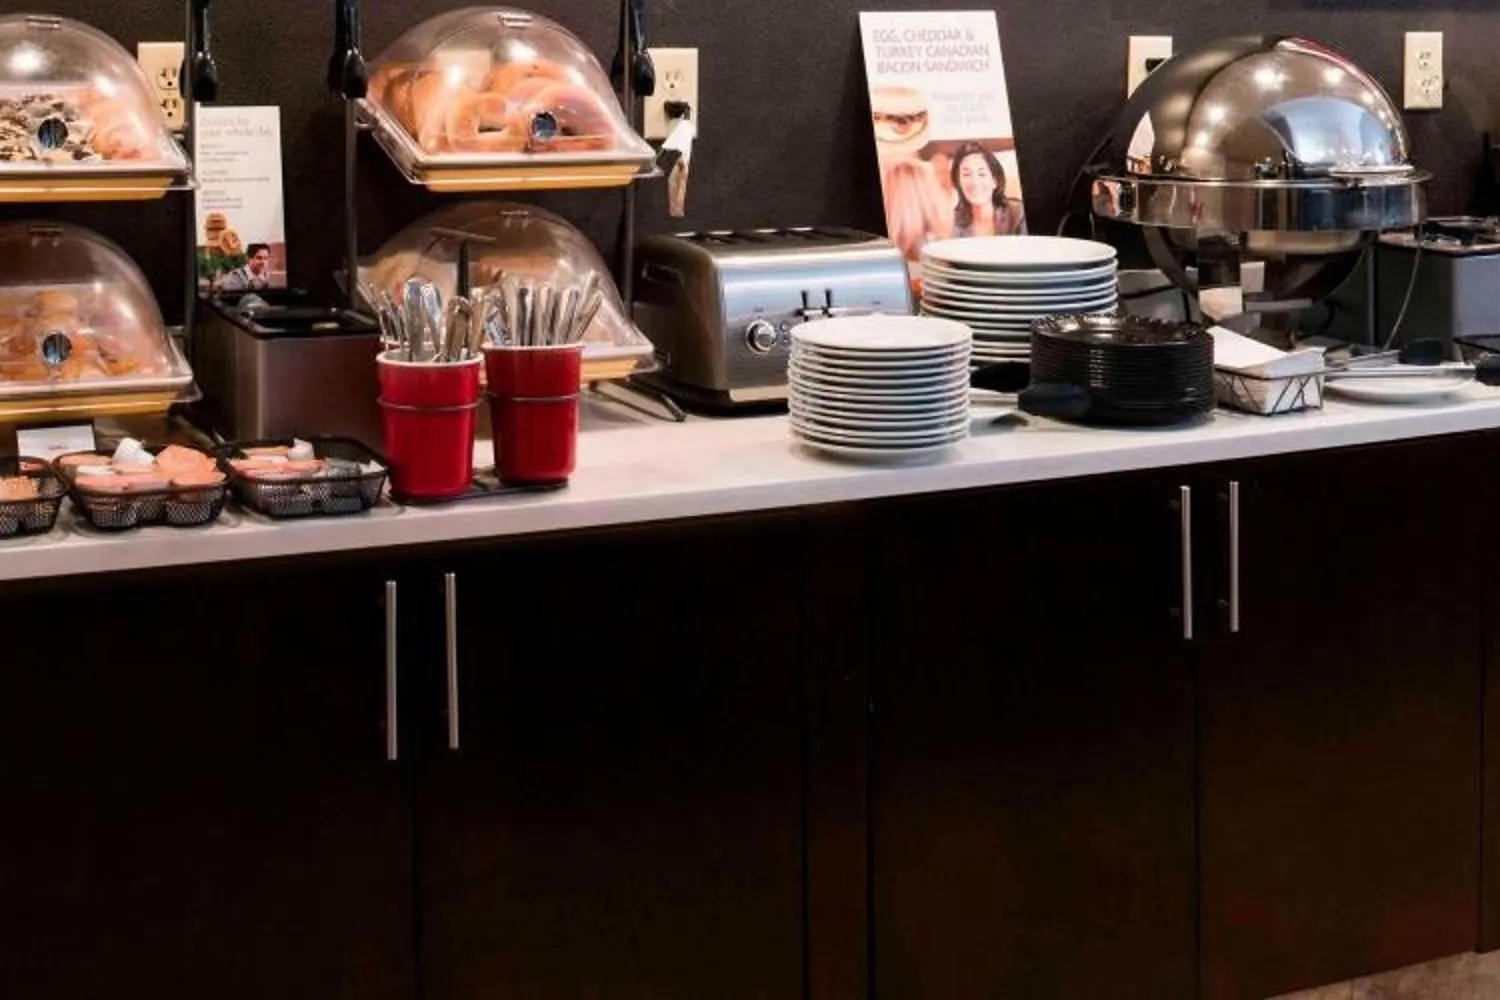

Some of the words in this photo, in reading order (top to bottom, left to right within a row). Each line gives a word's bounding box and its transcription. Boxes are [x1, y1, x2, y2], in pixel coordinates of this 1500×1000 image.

[903, 28, 961, 42] CHEDDAR
[965, 30, 975, 41] &
[875, 44, 923, 58] TURKEY
[925, 43, 990, 57] CANADIAN
[877, 60, 920, 73] BACON
[923, 59, 990, 72] SANDWICH
